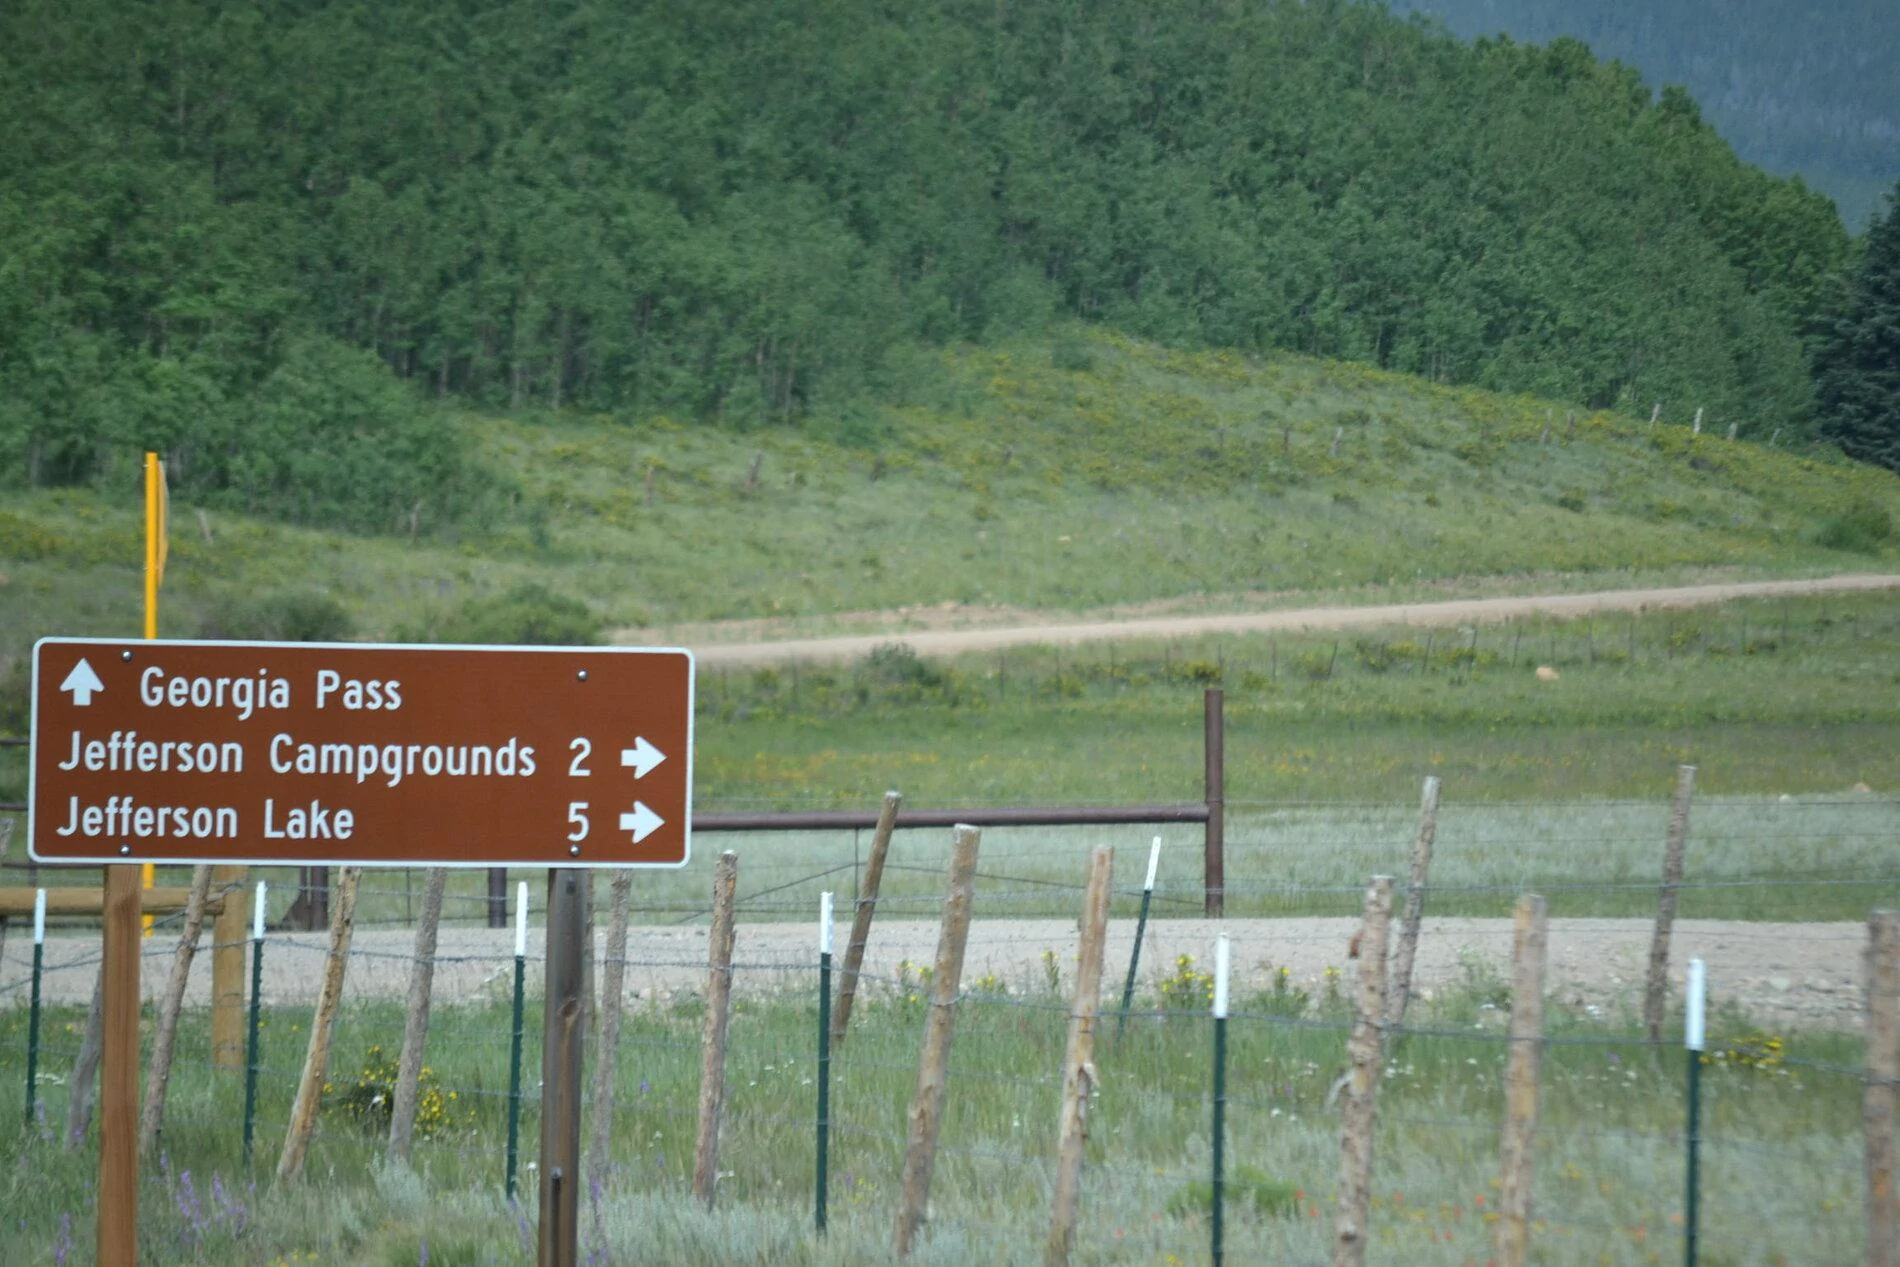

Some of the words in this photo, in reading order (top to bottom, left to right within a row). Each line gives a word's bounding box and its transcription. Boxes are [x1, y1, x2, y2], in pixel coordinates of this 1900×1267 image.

[140, 666, 290, 721] Georgia
[316, 669, 402, 711] Pass
[58, 730, 243, 773] Jefferson
[270, 733, 537, 788] Campgrounds
[568, 736, 592, 777] 2
[56, 796, 238, 838] Jefferson
[264, 798, 354, 840] Lake
[567, 801, 590, 842] 5
